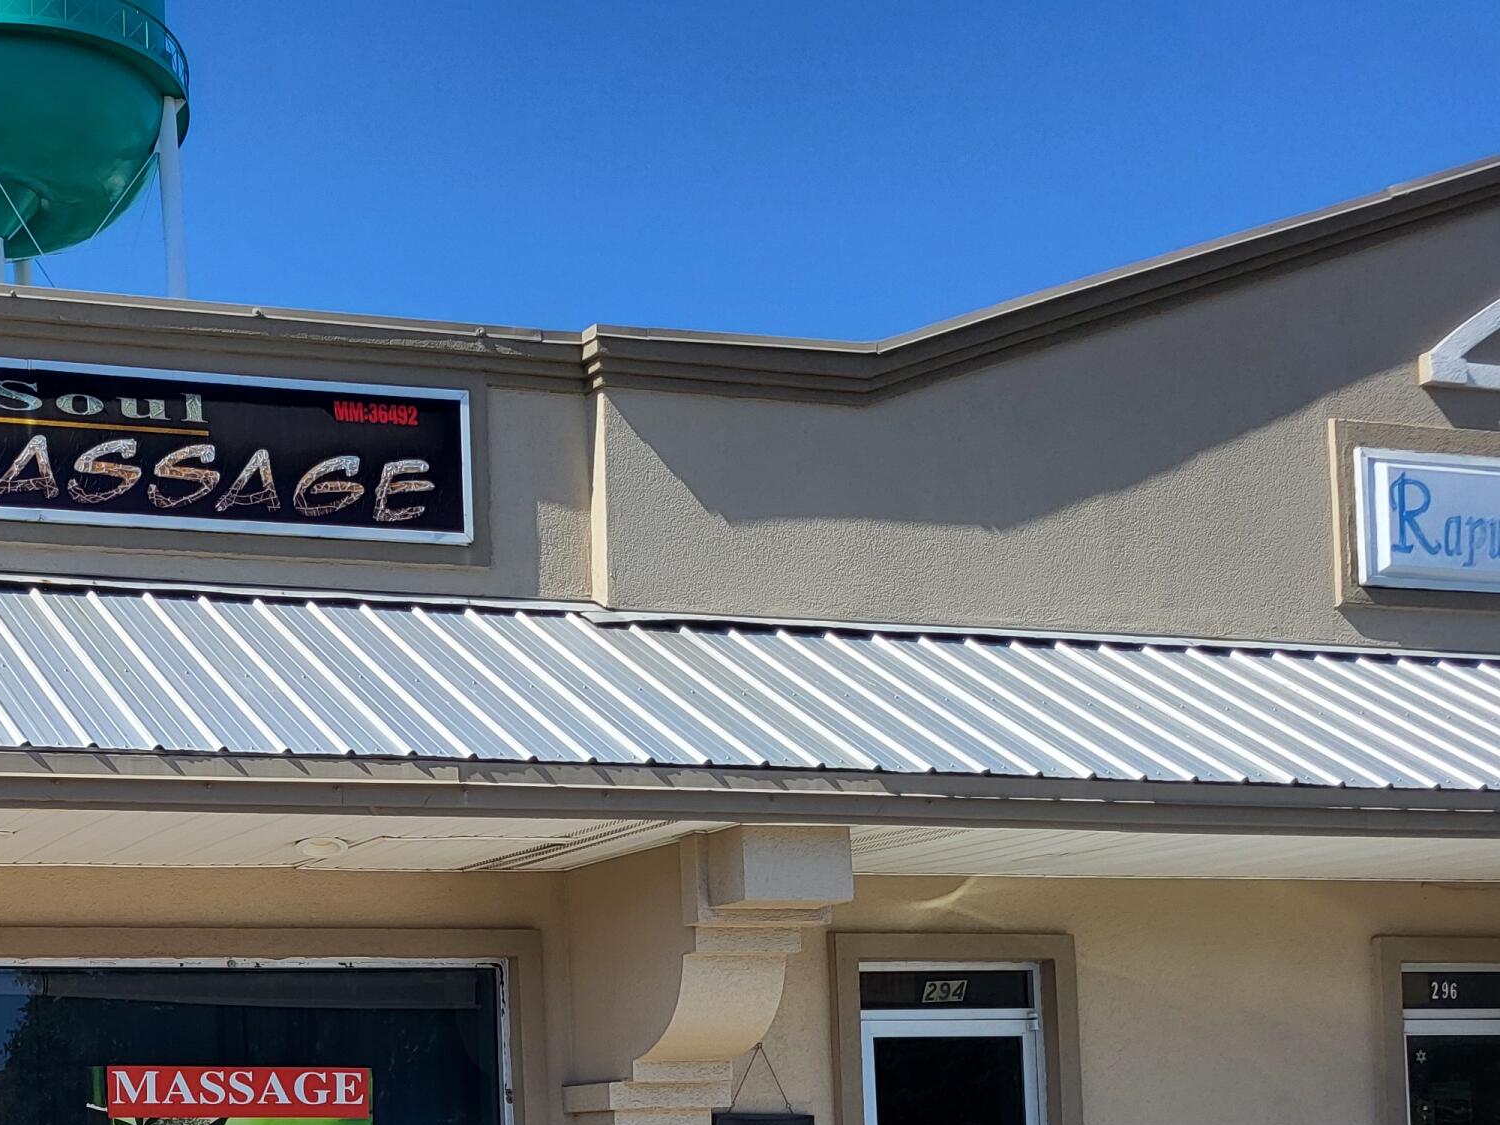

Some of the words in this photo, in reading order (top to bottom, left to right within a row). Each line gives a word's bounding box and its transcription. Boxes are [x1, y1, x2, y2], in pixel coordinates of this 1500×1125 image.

[333, 400, 419, 427] MM:36492
[924, 981, 966, 1001] 294
[1431, 981, 1458, 999] 296
[112, 1070, 364, 1105] MASSAGE
